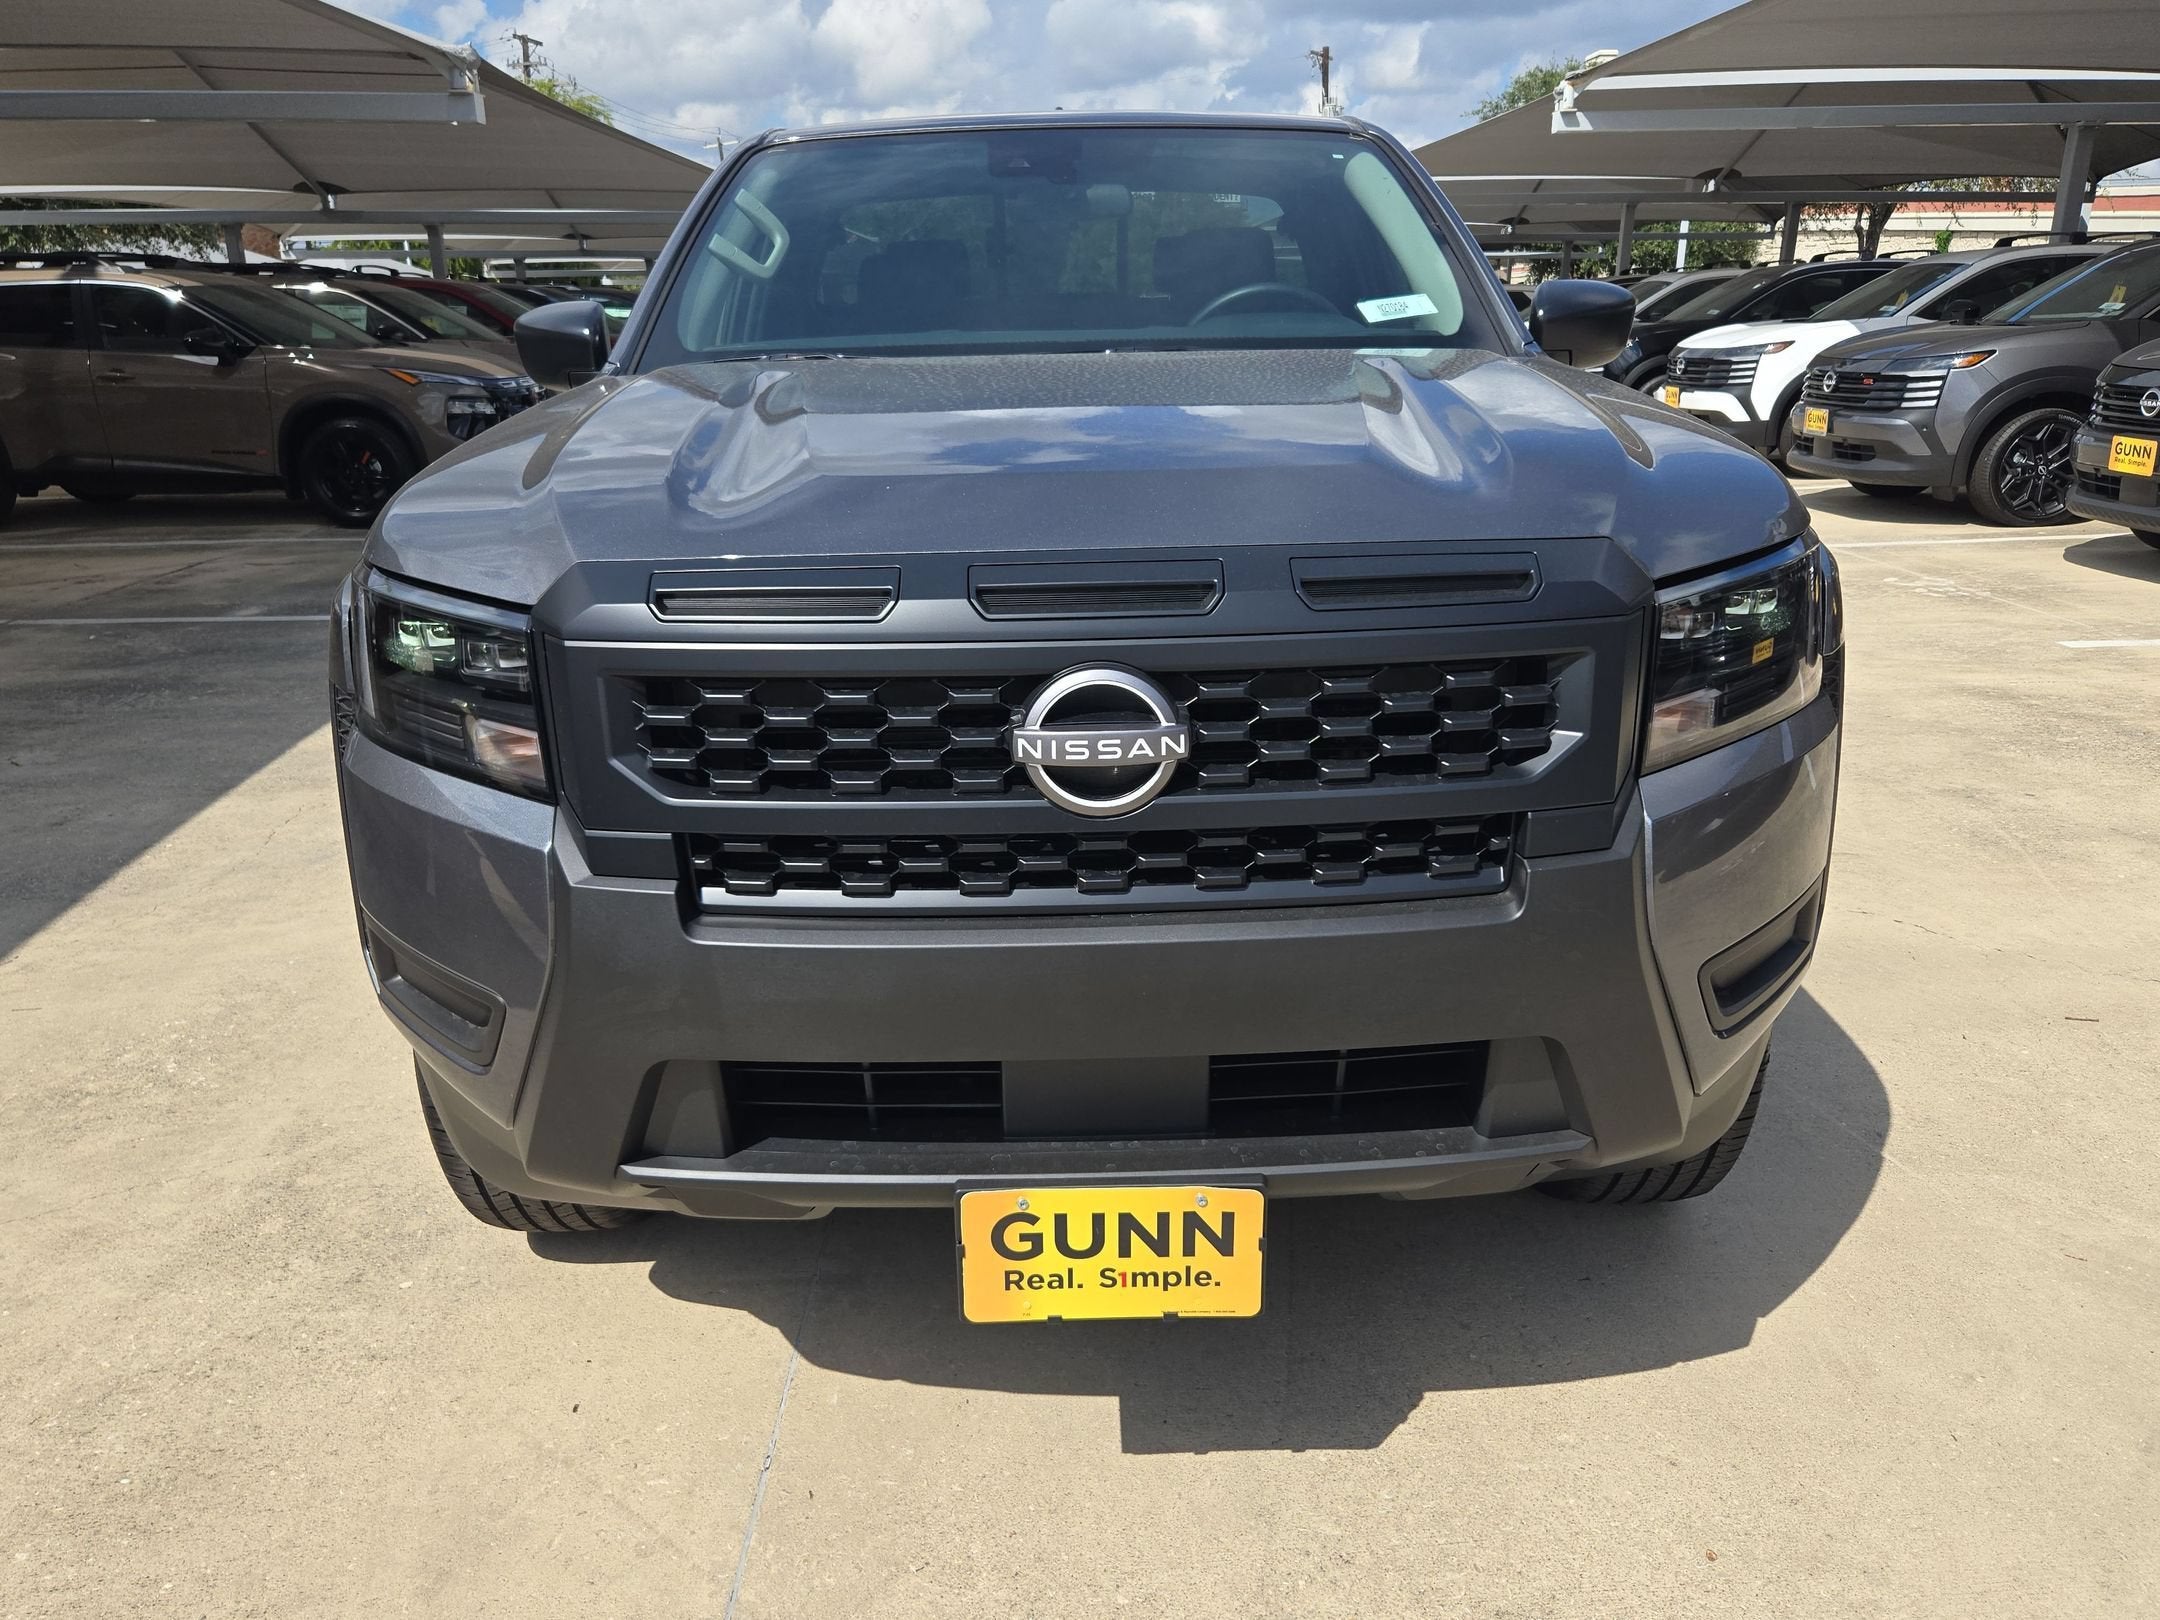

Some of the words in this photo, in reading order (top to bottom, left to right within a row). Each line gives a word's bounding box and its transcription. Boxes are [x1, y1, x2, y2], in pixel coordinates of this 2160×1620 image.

[1807, 412, 1826, 424] GUNN
[2115, 442, 2152, 459] GUNN
[1017, 734, 1185, 760] NISSAN
[990, 1210, 1236, 1261] GUNN
[1004, 1268, 1084, 1291] Real.
